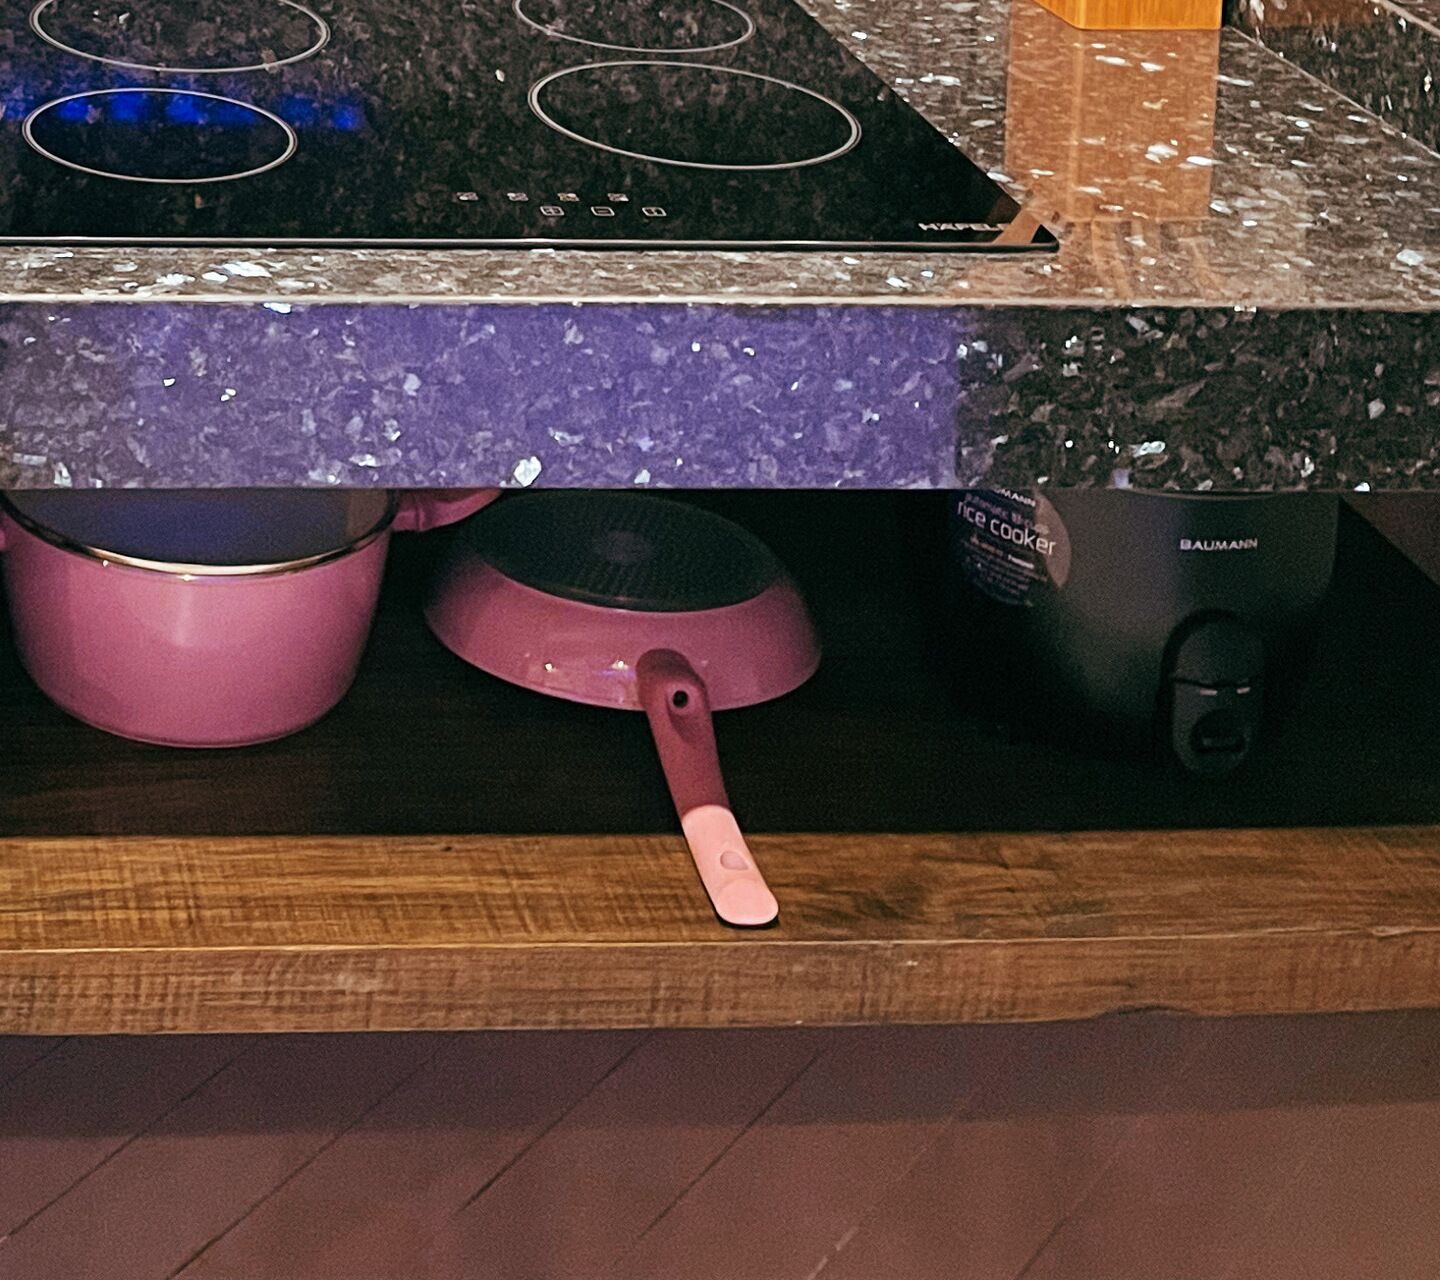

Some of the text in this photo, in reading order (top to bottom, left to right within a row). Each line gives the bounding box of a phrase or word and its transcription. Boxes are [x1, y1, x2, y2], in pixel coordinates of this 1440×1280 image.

[957, 500, 986, 529] rice
[990, 519, 1057, 556] cooker
[1180, 538, 1258, 551] BAUMANN
